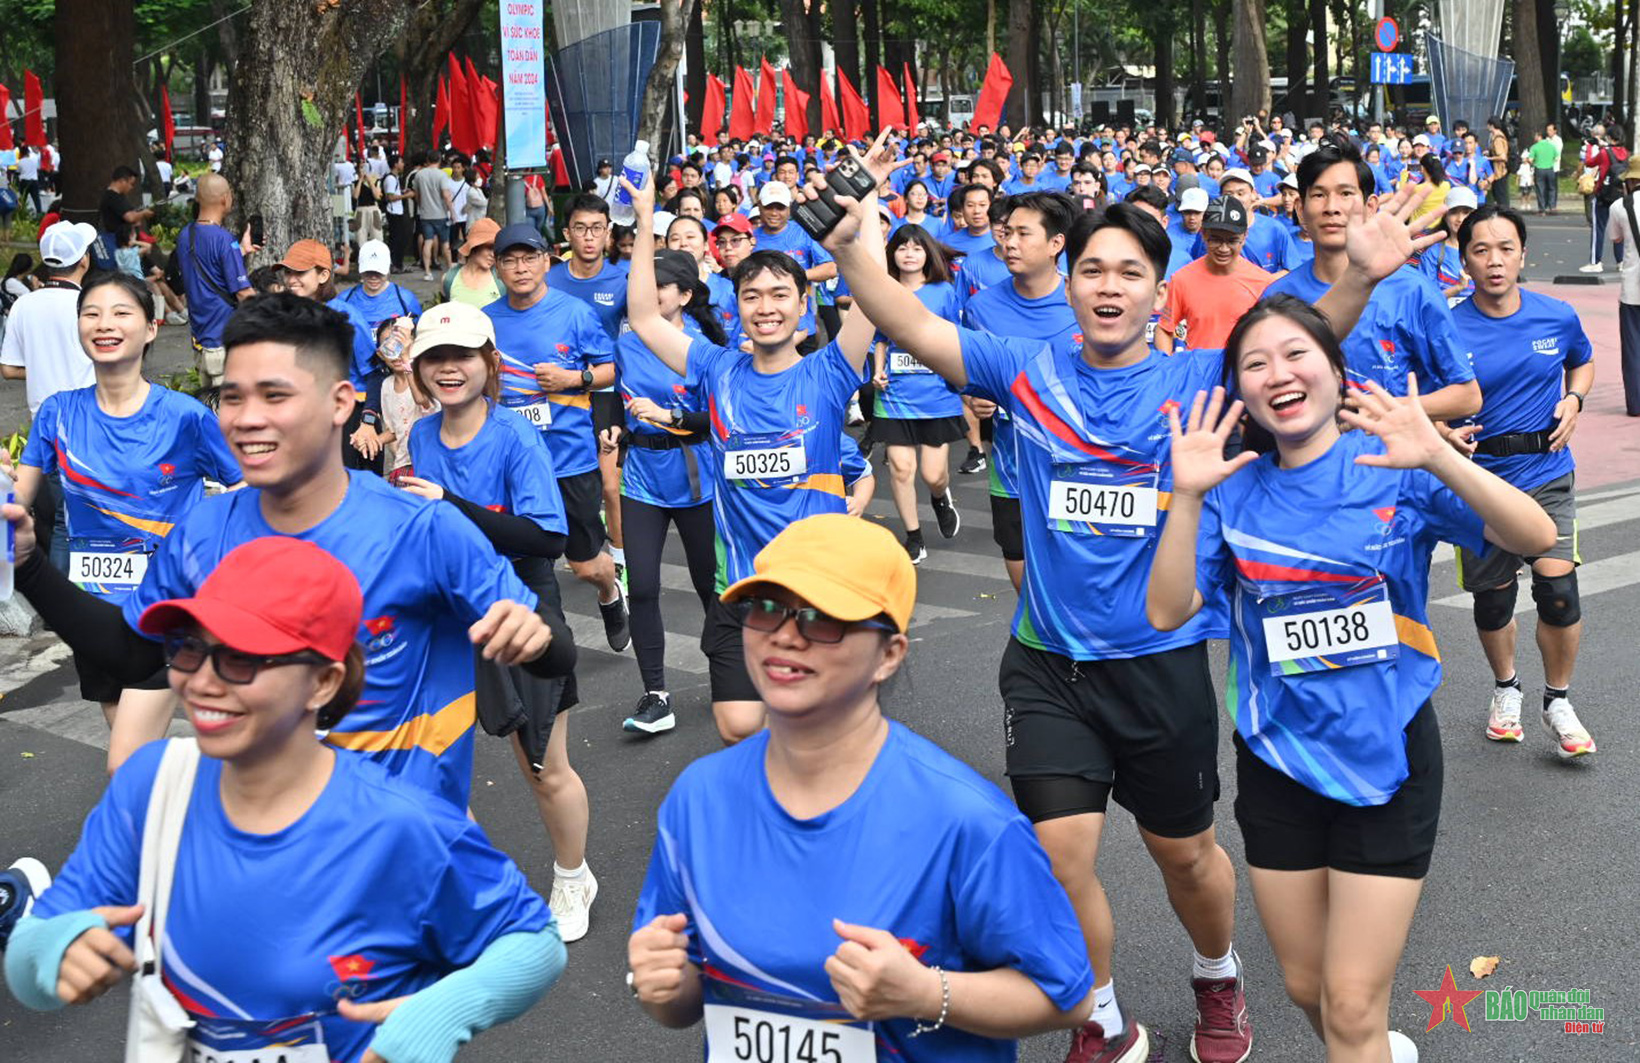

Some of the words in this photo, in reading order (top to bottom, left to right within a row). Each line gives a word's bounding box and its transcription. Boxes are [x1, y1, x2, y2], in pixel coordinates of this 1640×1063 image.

[507, 4, 534, 16] OLYMPIC
[524, 73, 539, 84] 2024
[736, 452, 790, 475] 50325
[1065, 487, 1134, 518] 50470
[81, 556, 133, 579] 50324
[1284, 611, 1369, 651] 50138
[734, 1016, 843, 1063] 50145
